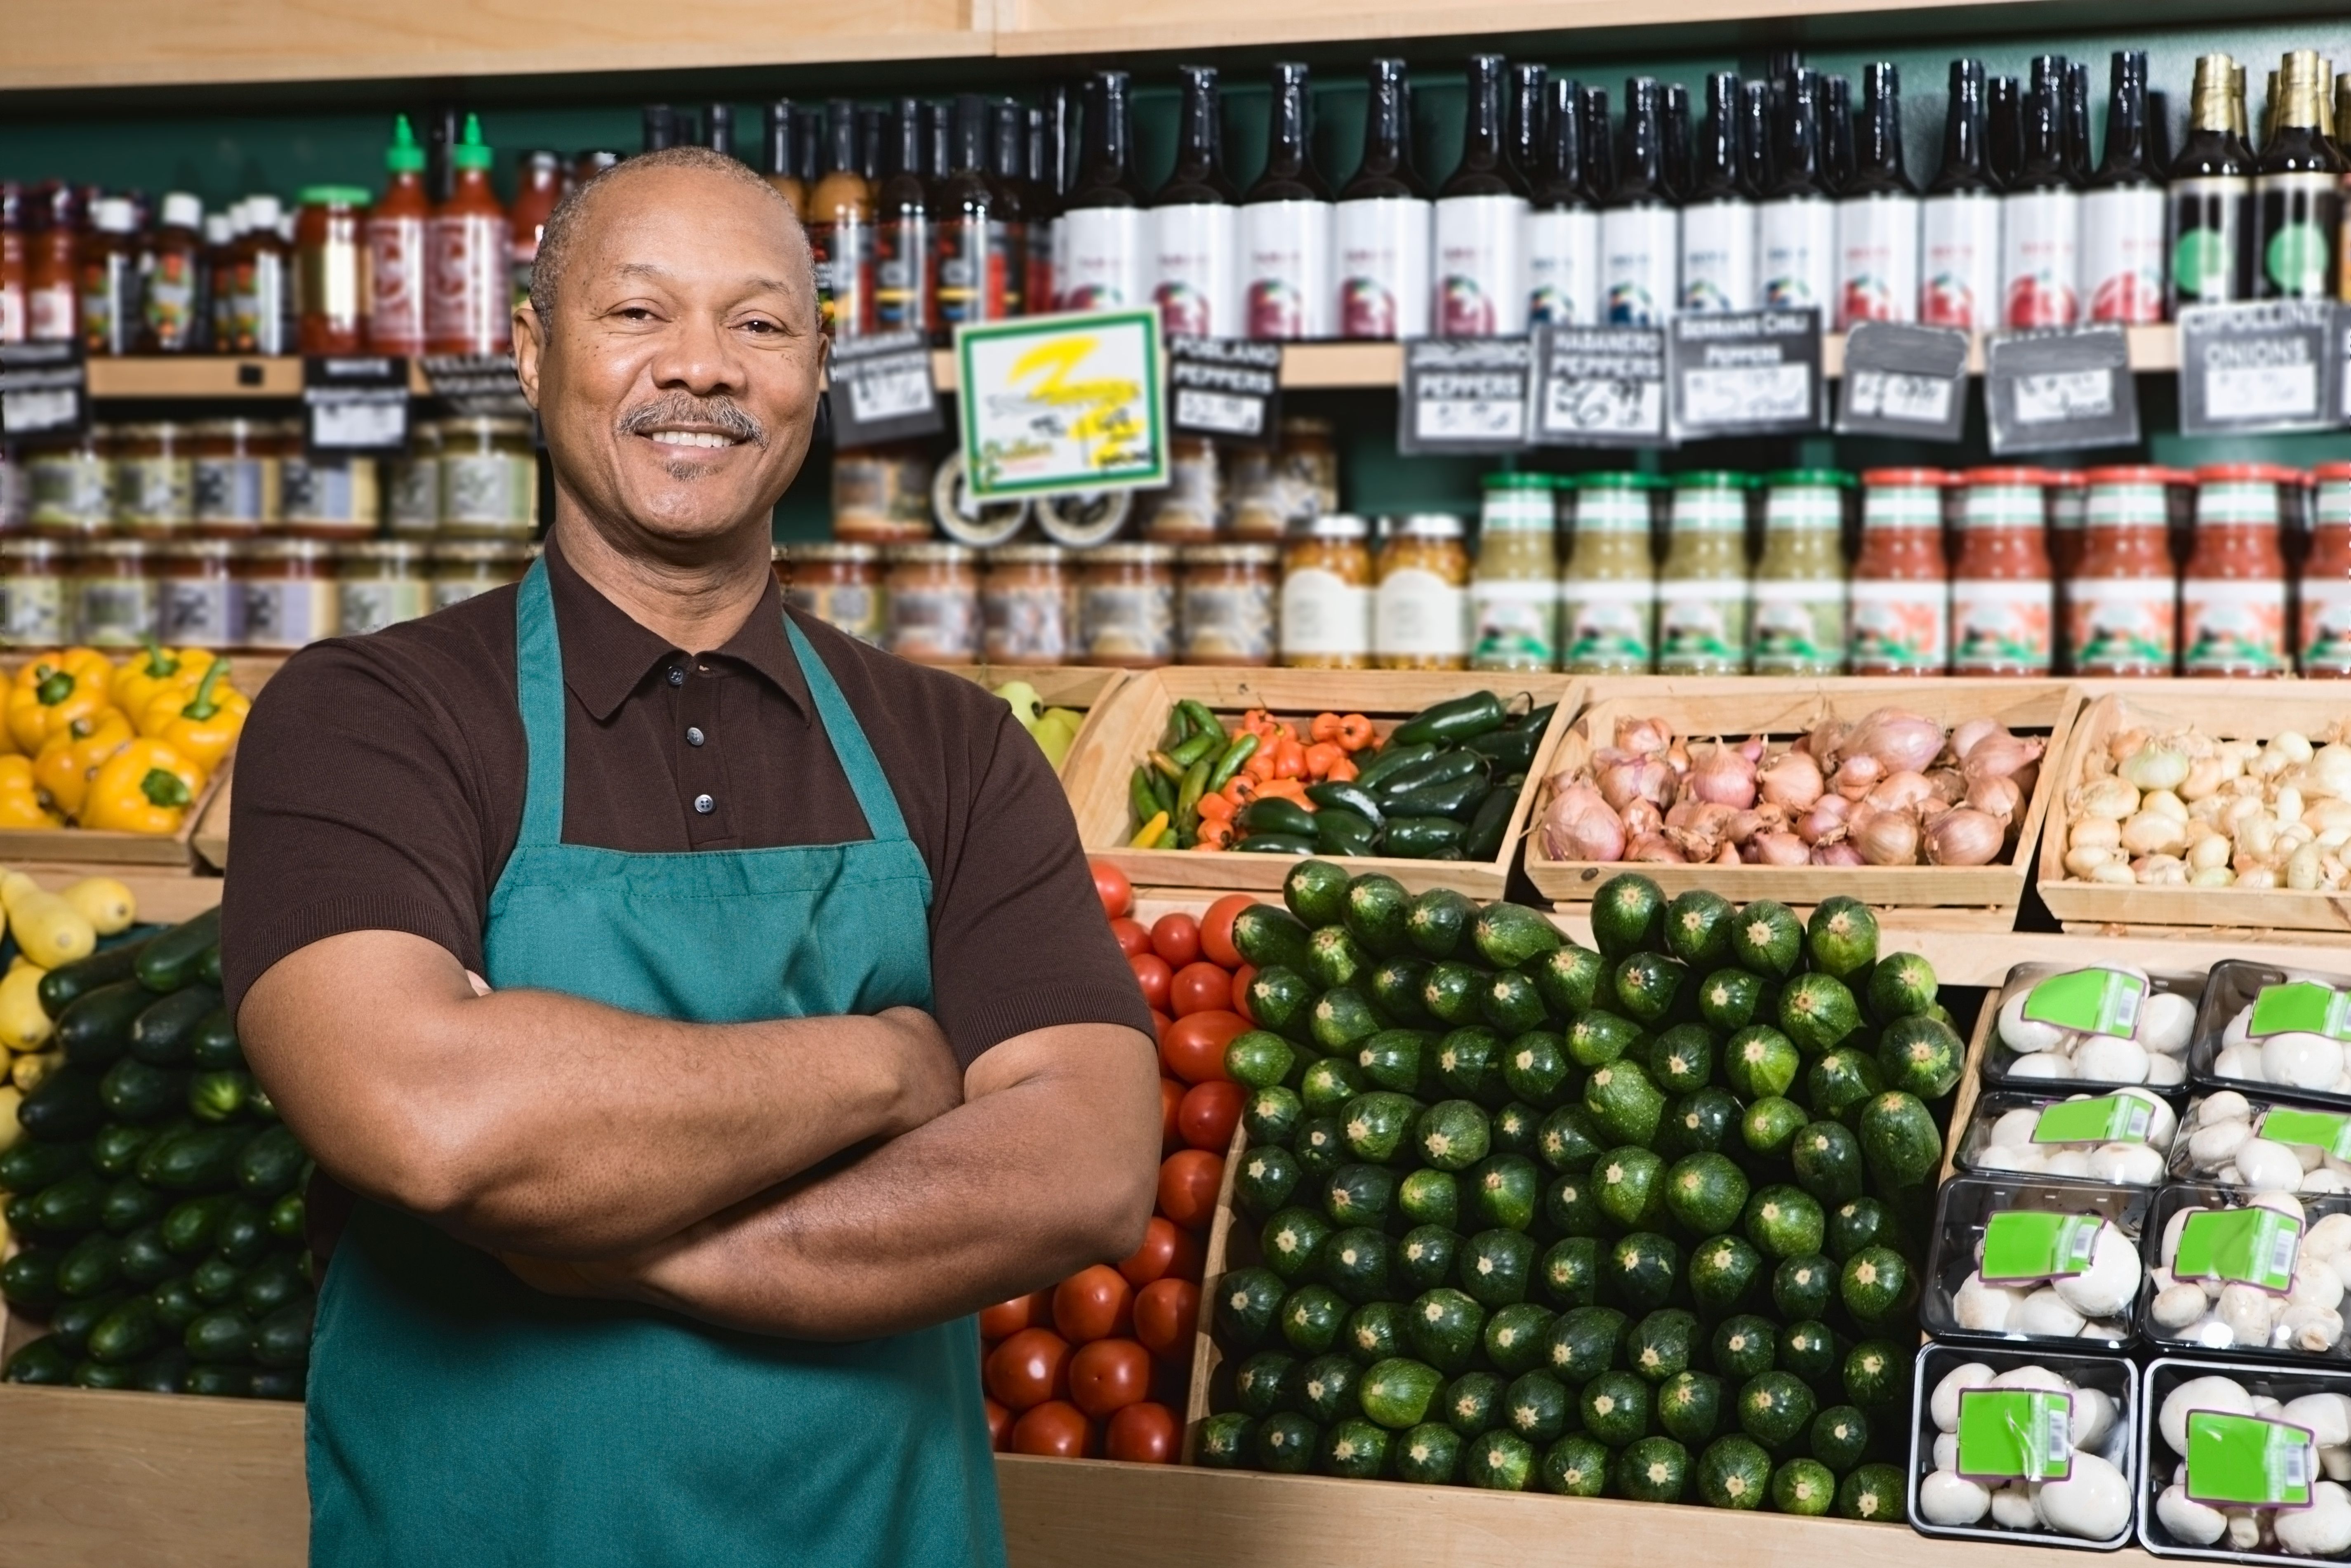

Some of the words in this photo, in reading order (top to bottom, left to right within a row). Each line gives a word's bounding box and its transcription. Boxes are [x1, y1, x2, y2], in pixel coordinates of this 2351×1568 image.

[1553, 330, 1660, 351] HABANERO
[2203, 339, 2308, 368] ONIONS
[1173, 363, 1274, 395] PEPPERS
[1552, 355, 1660, 379] PEPPERS
[1417, 374, 1520, 400] PEPPERS
[2251, 1210, 2276, 1283] MUSHROOMS
